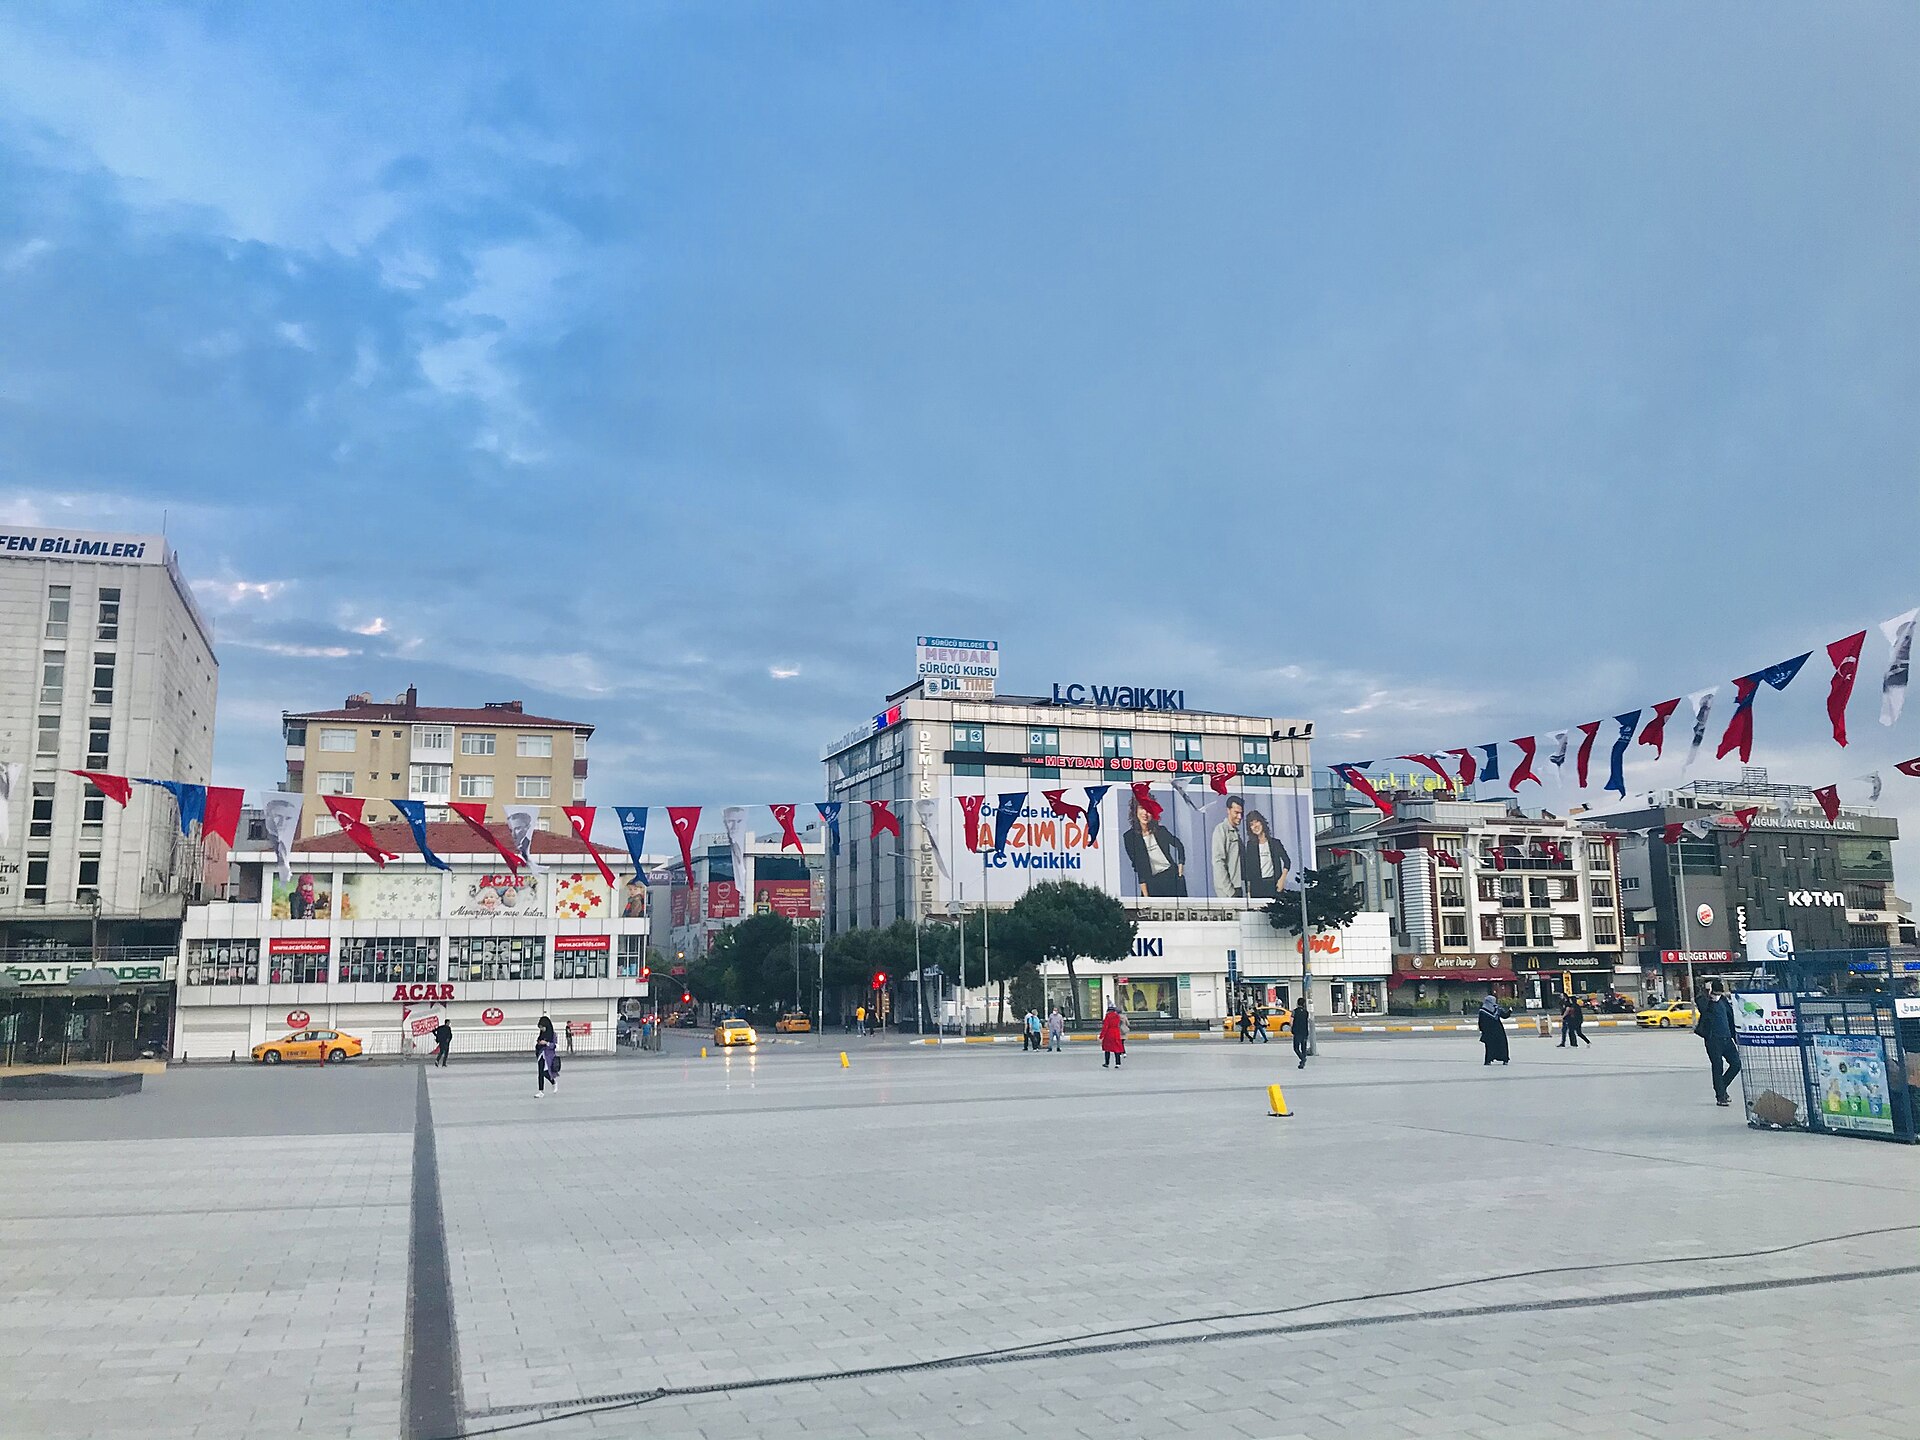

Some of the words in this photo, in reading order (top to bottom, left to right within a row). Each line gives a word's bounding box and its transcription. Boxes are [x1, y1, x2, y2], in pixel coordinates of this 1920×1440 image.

[39, 537, 146, 558] BİLİMLERİ
[925, 648, 991, 664] MEYDAN
[919, 661, 960, 675] SÜRÜCÜ
[963, 665, 997, 677] KURSU
[963, 678, 993, 691] TIME
[1053, 683, 1085, 705] LC
[1045, 755, 1104, 768] MEYDAN
[1110, 756, 1178, 772] SÜRÜCÜ
[1182, 761, 1237, 775] KURSU
[1243, 763, 1264, 776] 634
[1267, 764, 1281, 776] 07
[1011, 852, 1081, 869] Waikiki
[480, 874, 525, 888] ACAR
[1558, 957, 1600, 966] McDonald's
[1678, 951, 1706, 961] BURGER
[1708, 952, 1728, 961] KING
[393, 984, 455, 1000] ACAR
